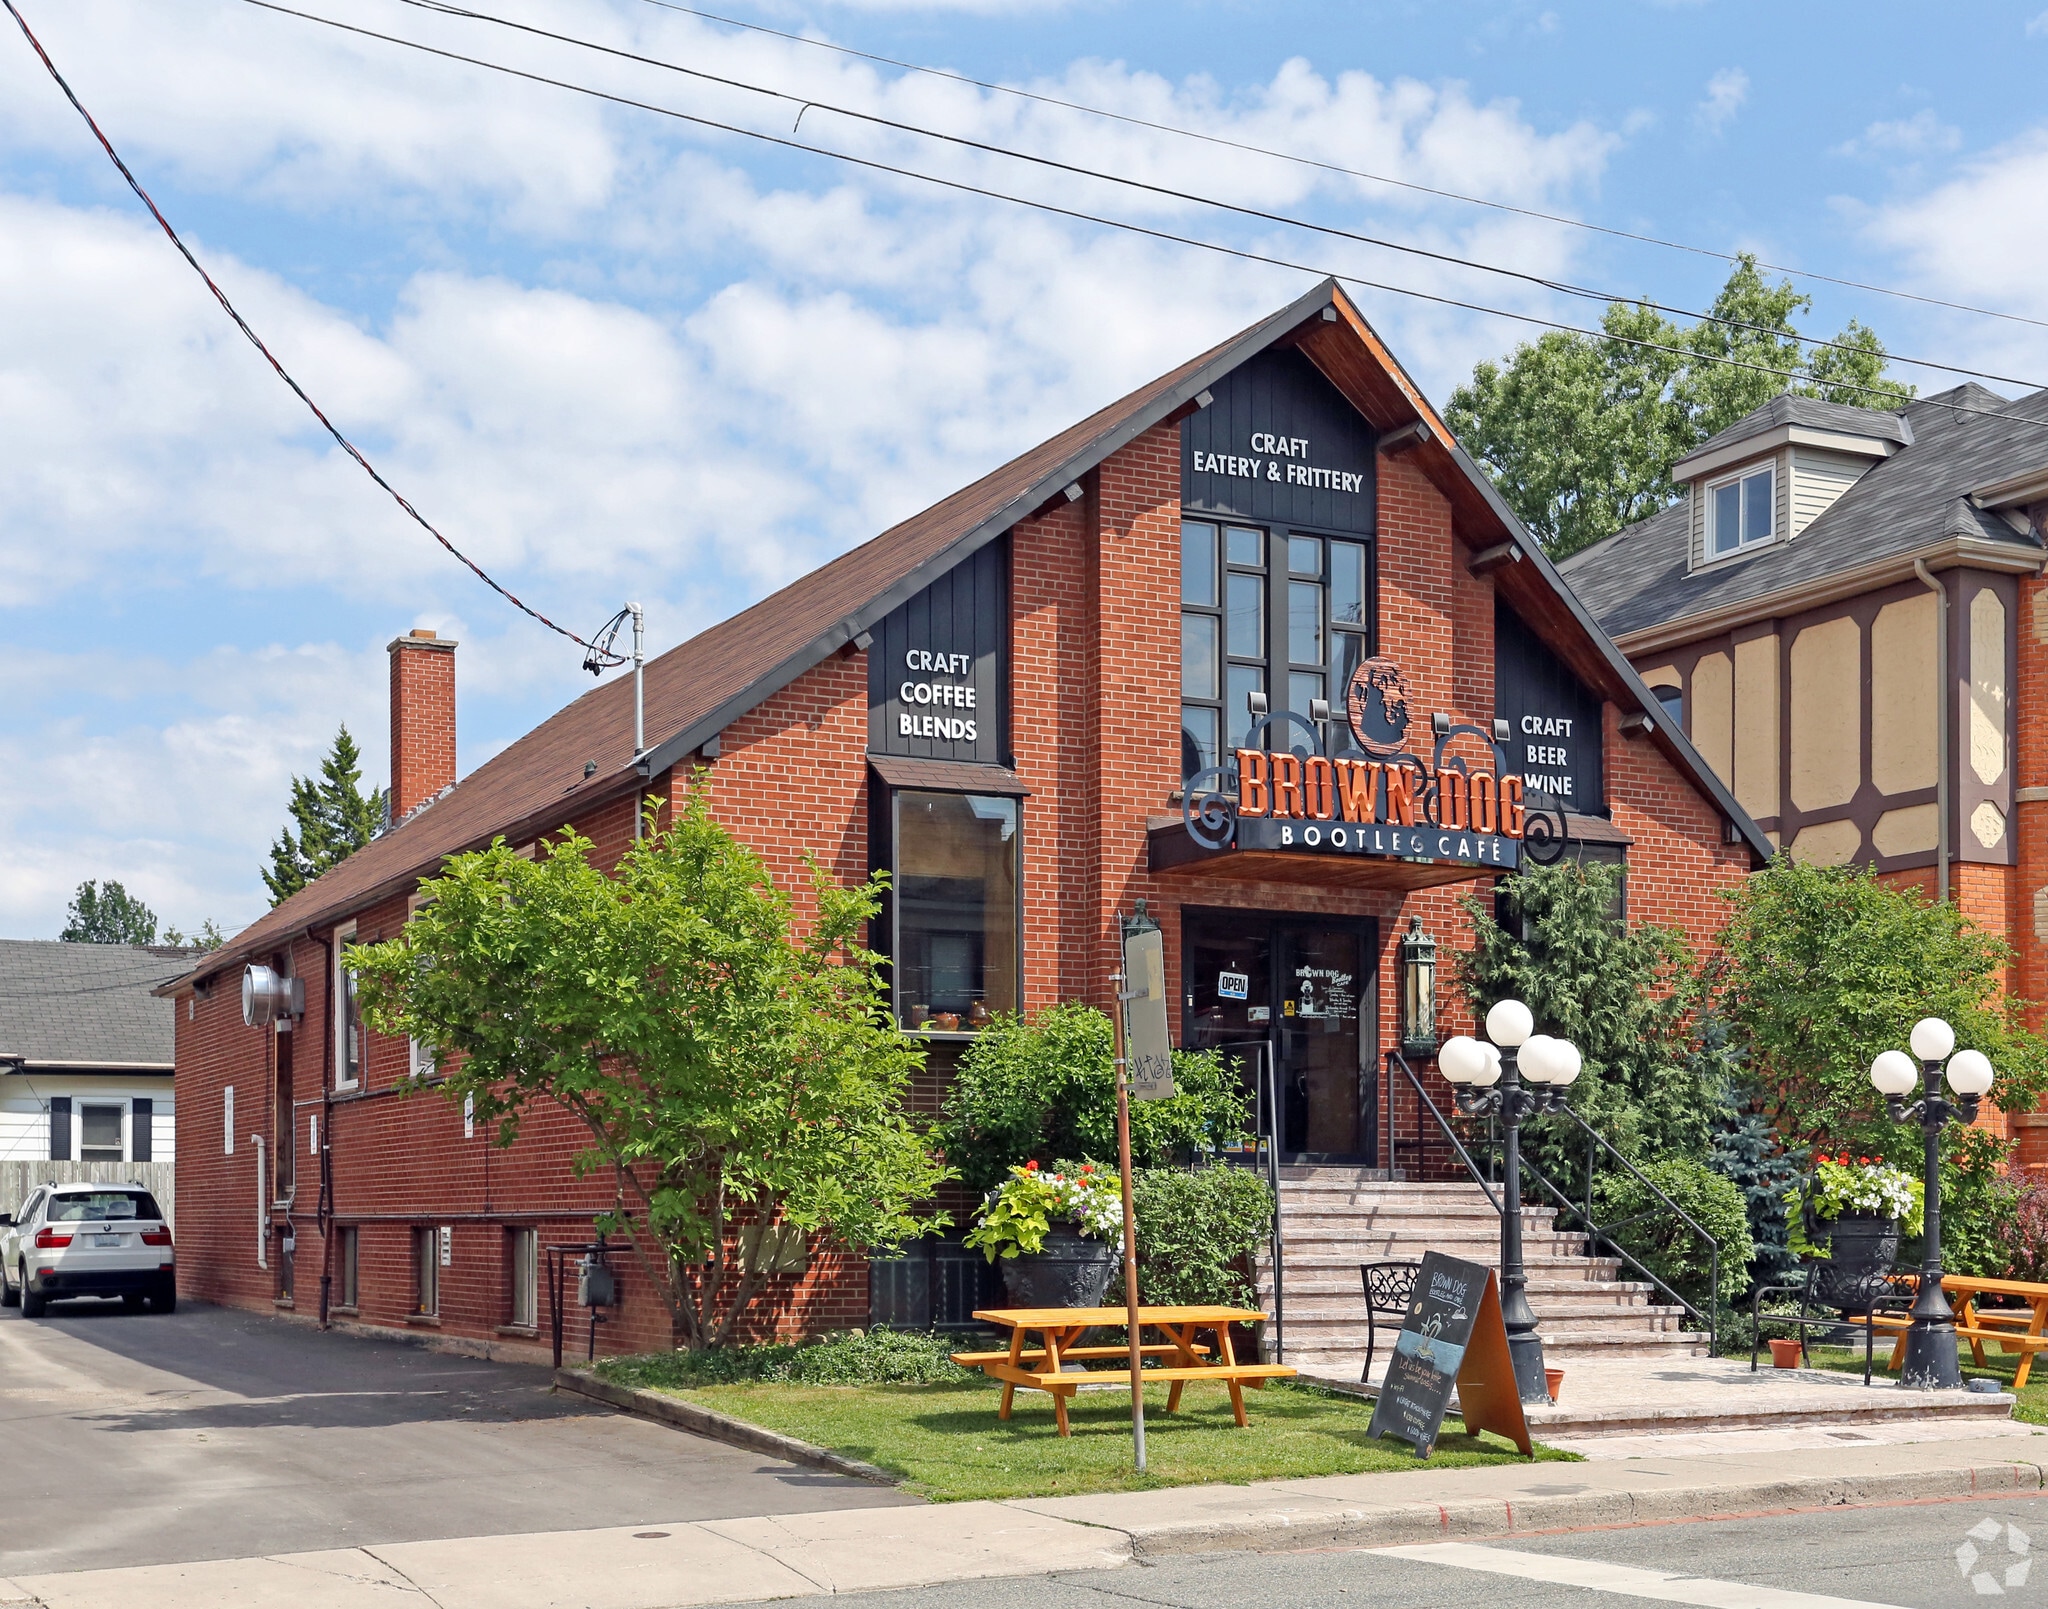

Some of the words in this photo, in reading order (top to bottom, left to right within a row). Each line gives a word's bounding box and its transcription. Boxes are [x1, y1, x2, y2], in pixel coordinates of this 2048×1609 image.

[1250, 432, 1309, 459] CRAFT
[1193, 450, 1262, 479] EATERY
[1266, 461, 1282, 482] &
[1286, 463, 1364, 494] FRITTERY
[905, 649, 970, 675] CRAFT
[900, 681, 976, 708] COFFEE
[899, 713, 978, 741] BLENDS
[1520, 715, 1573, 738] CRAFT
[1526, 744, 1568, 767] BEER
[1236, 749, 1416, 827] BROWN
[1437, 767, 1525, 840] DOG
[1524, 772, 1573, 796] WINE
[1281, 825, 1425, 854] BOOTLEG
[1437, 836, 1501, 862] CAFÉ
[1222, 976, 1246, 993] OPEN
[1325, 969, 1340, 978] DOG
[1451, 1279, 1468, 1298] DOG
